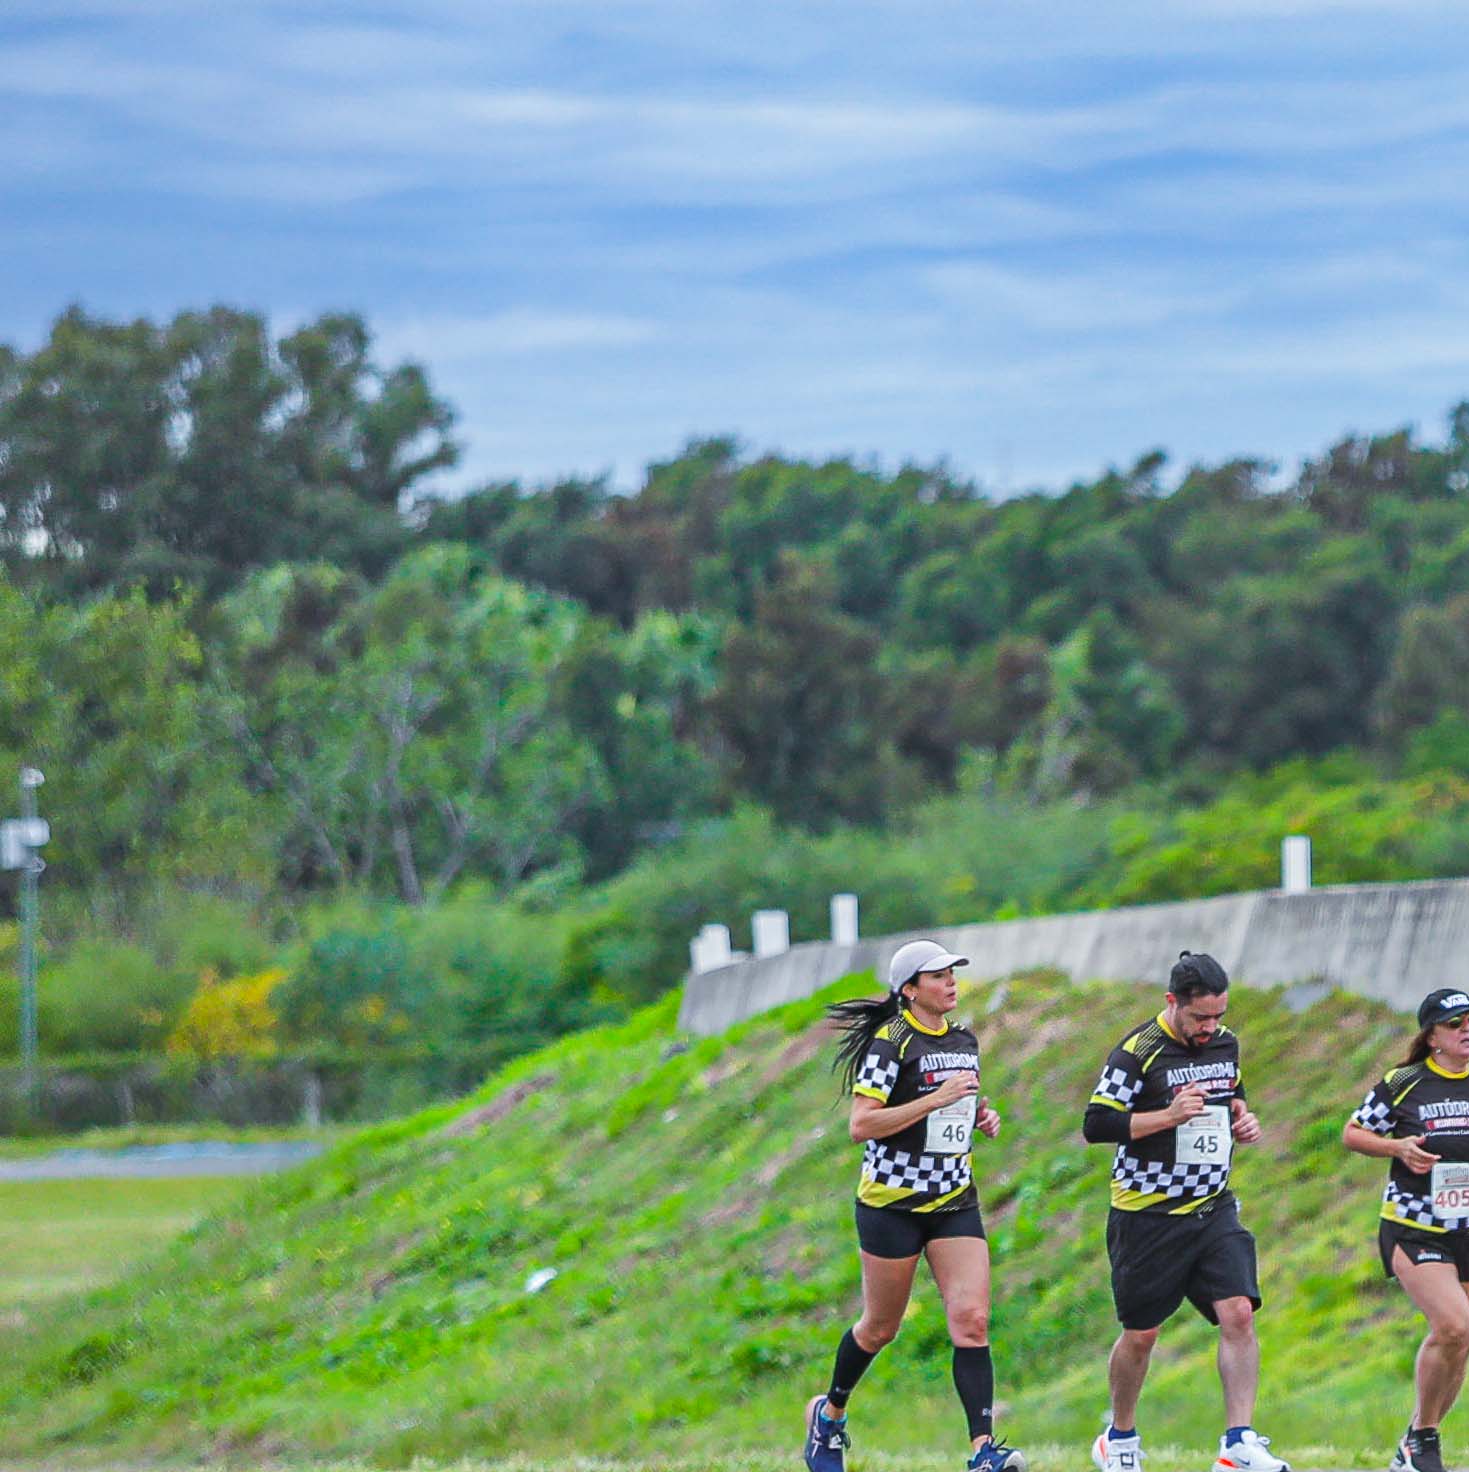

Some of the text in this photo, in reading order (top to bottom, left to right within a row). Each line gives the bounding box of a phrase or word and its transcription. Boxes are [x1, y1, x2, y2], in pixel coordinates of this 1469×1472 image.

[920, 1052, 980, 1072] AUTÓDROM
[1167, 1062, 1236, 1087] AUTÓDROM
[943, 1124, 966, 1143] 46
[1194, 1136, 1218, 1153] 45
